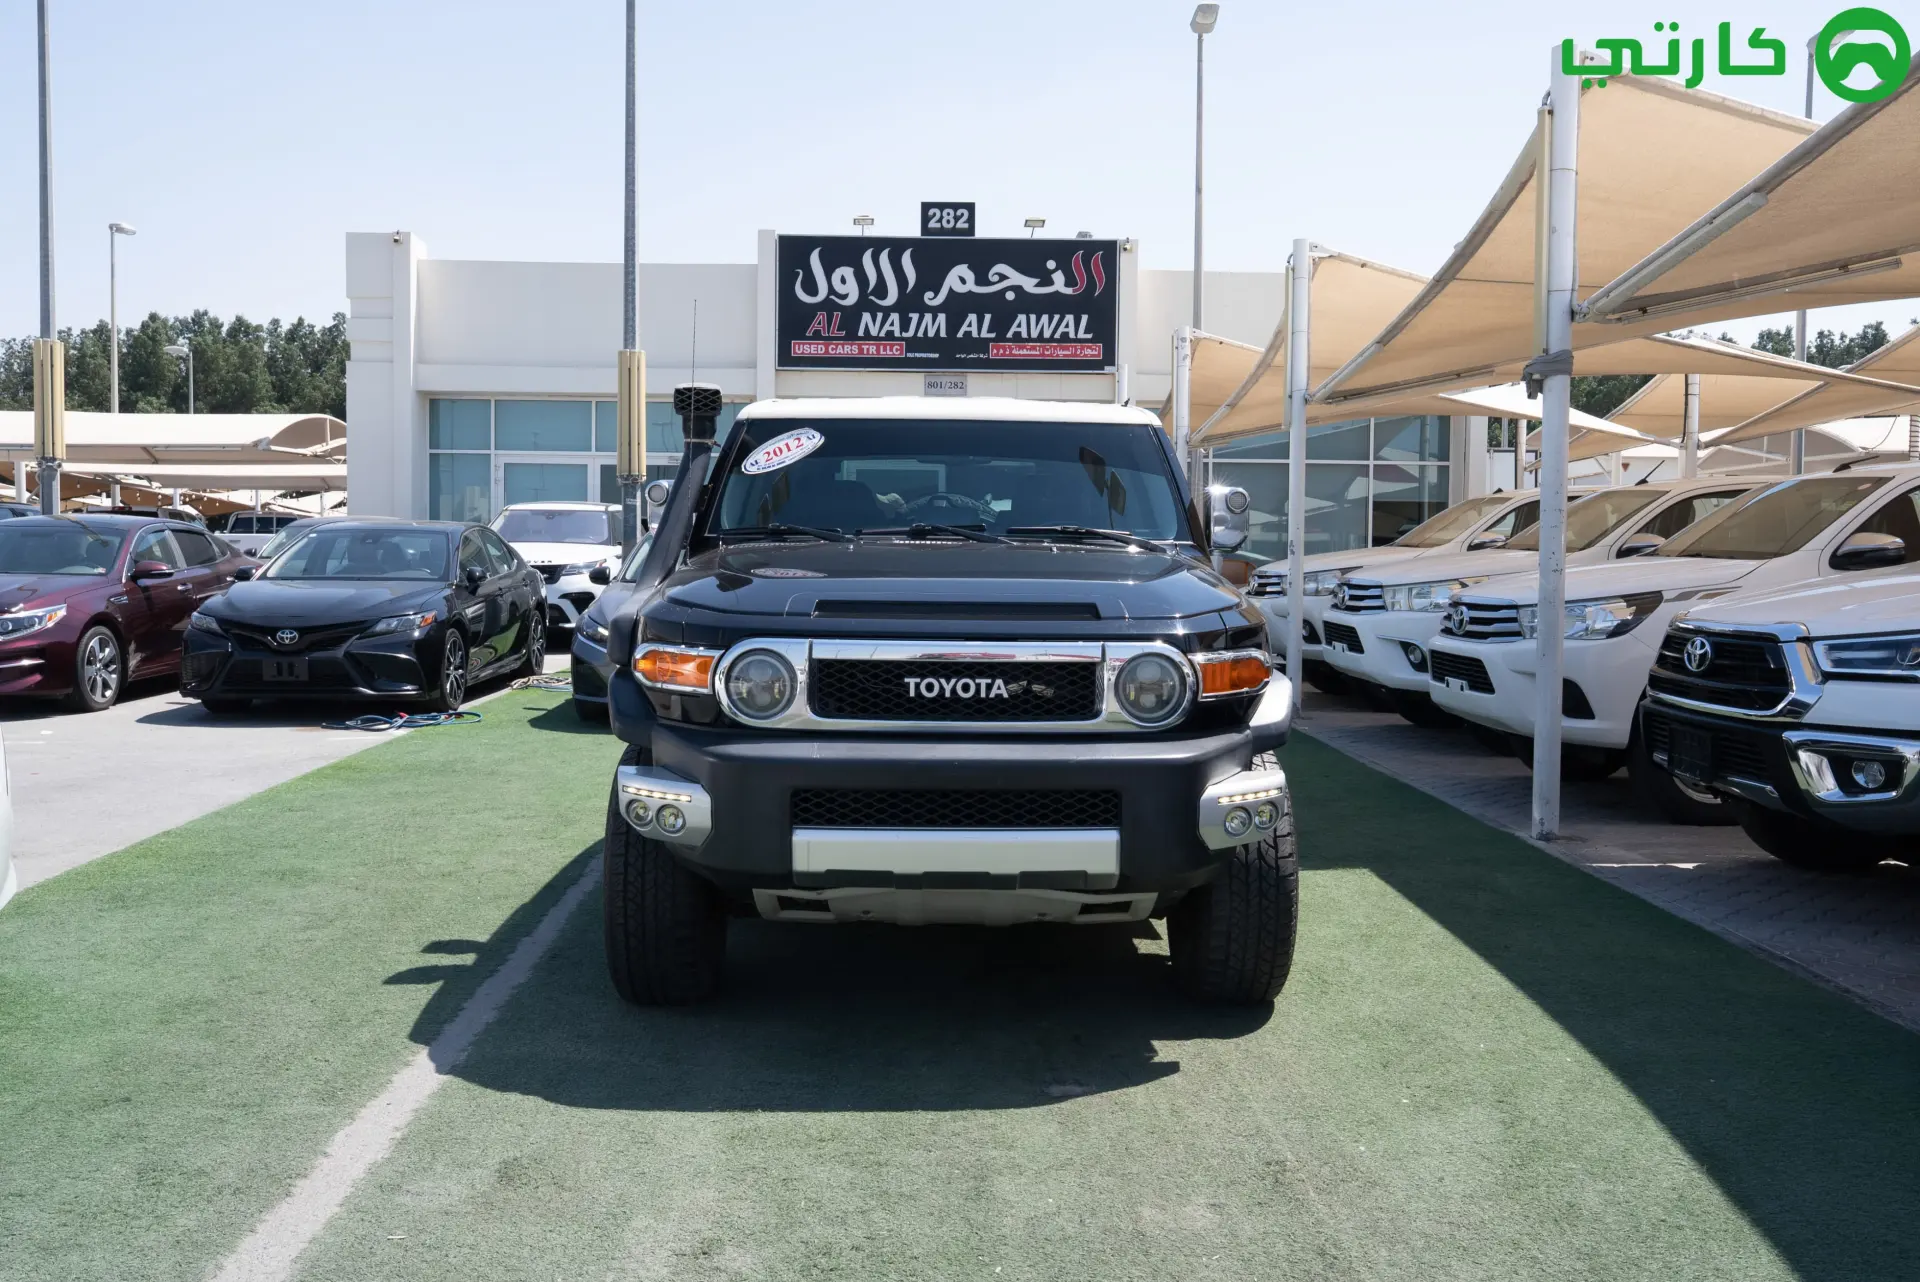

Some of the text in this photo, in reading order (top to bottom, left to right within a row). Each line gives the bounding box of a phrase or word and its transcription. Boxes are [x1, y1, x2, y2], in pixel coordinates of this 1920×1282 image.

[927, 208, 969, 229] 282
[923, 250, 1106, 306] النجم
[806, 311, 1094, 339] AL NAJM AL AWAL
[795, 344, 901, 355] USED CARS TR LLC
[1044, 345, 1075, 357] السيارات
[927, 380, 965, 390] 801/282
[763, 436, 804, 463] 2012
[904, 677, 1010, 699] TOYOTA
